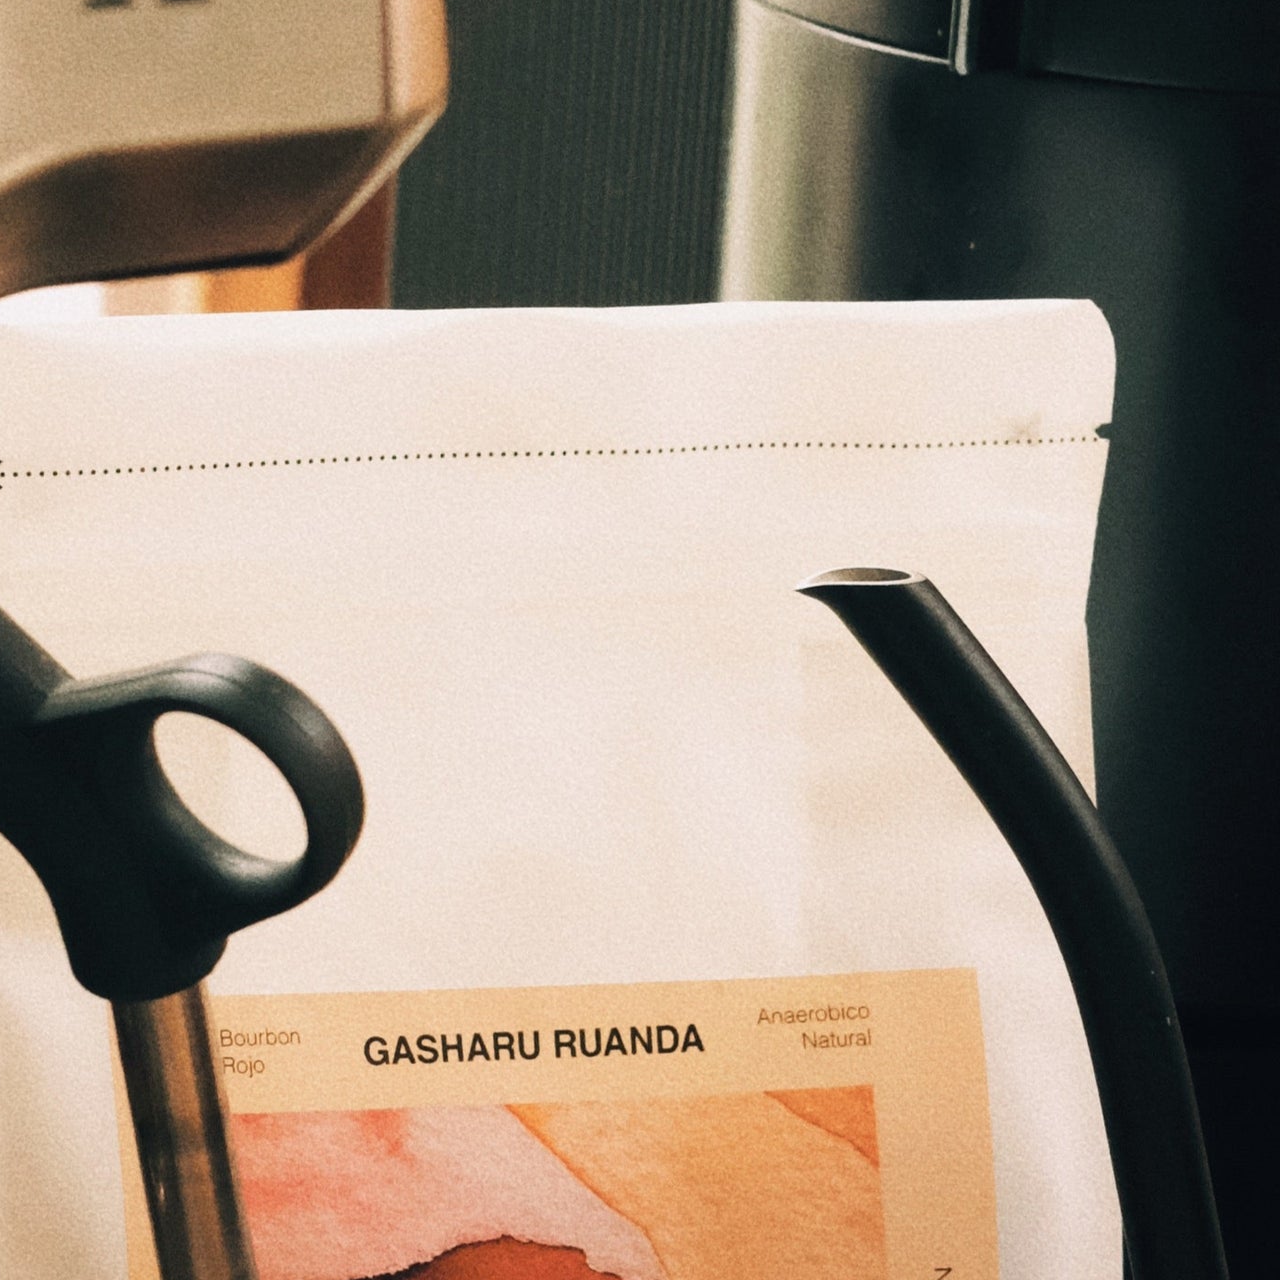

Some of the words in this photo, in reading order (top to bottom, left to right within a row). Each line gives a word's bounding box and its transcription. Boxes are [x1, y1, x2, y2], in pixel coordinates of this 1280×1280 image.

[220, 1028, 301, 1047] Bourbon
[363, 1030, 540, 1066] GASHARU
[553, 1023, 705, 1058] RUANDA
[802, 1028, 871, 1049] Natural
[222, 1057, 265, 1078] Rojo
